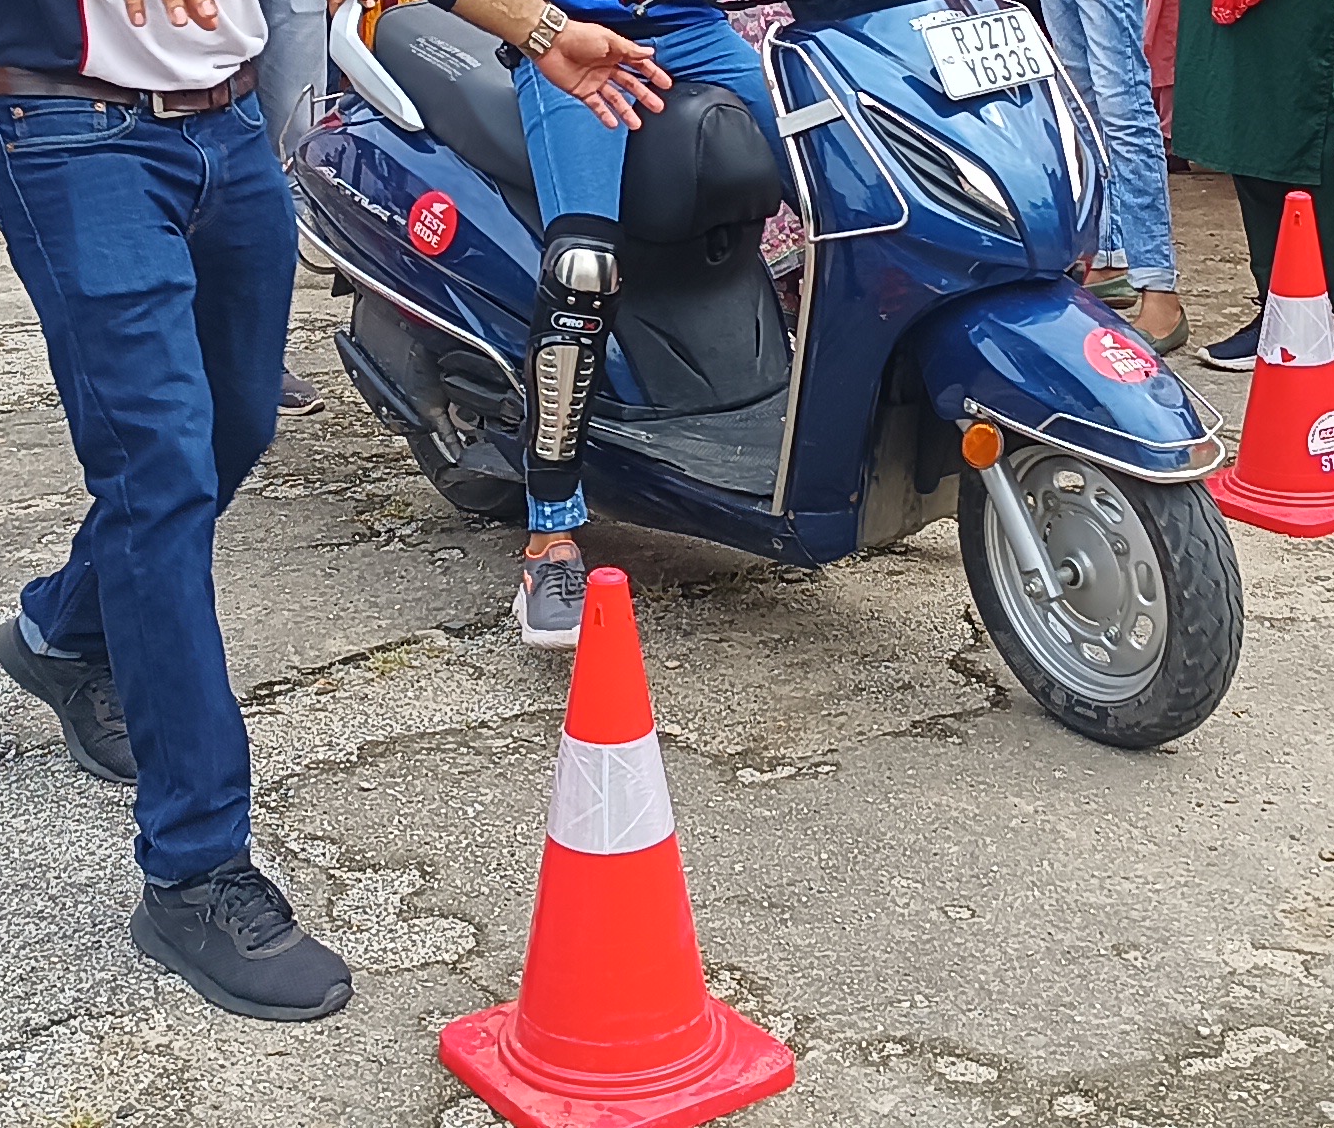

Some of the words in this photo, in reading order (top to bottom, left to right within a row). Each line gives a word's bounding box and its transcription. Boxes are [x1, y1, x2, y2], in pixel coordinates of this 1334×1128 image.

[951, 15, 1026, 55] RJ27B
[964, 47, 1040, 87] Y6336
[413, 222, 440, 248] RIDE
[421, 209, 446, 235] TEST
